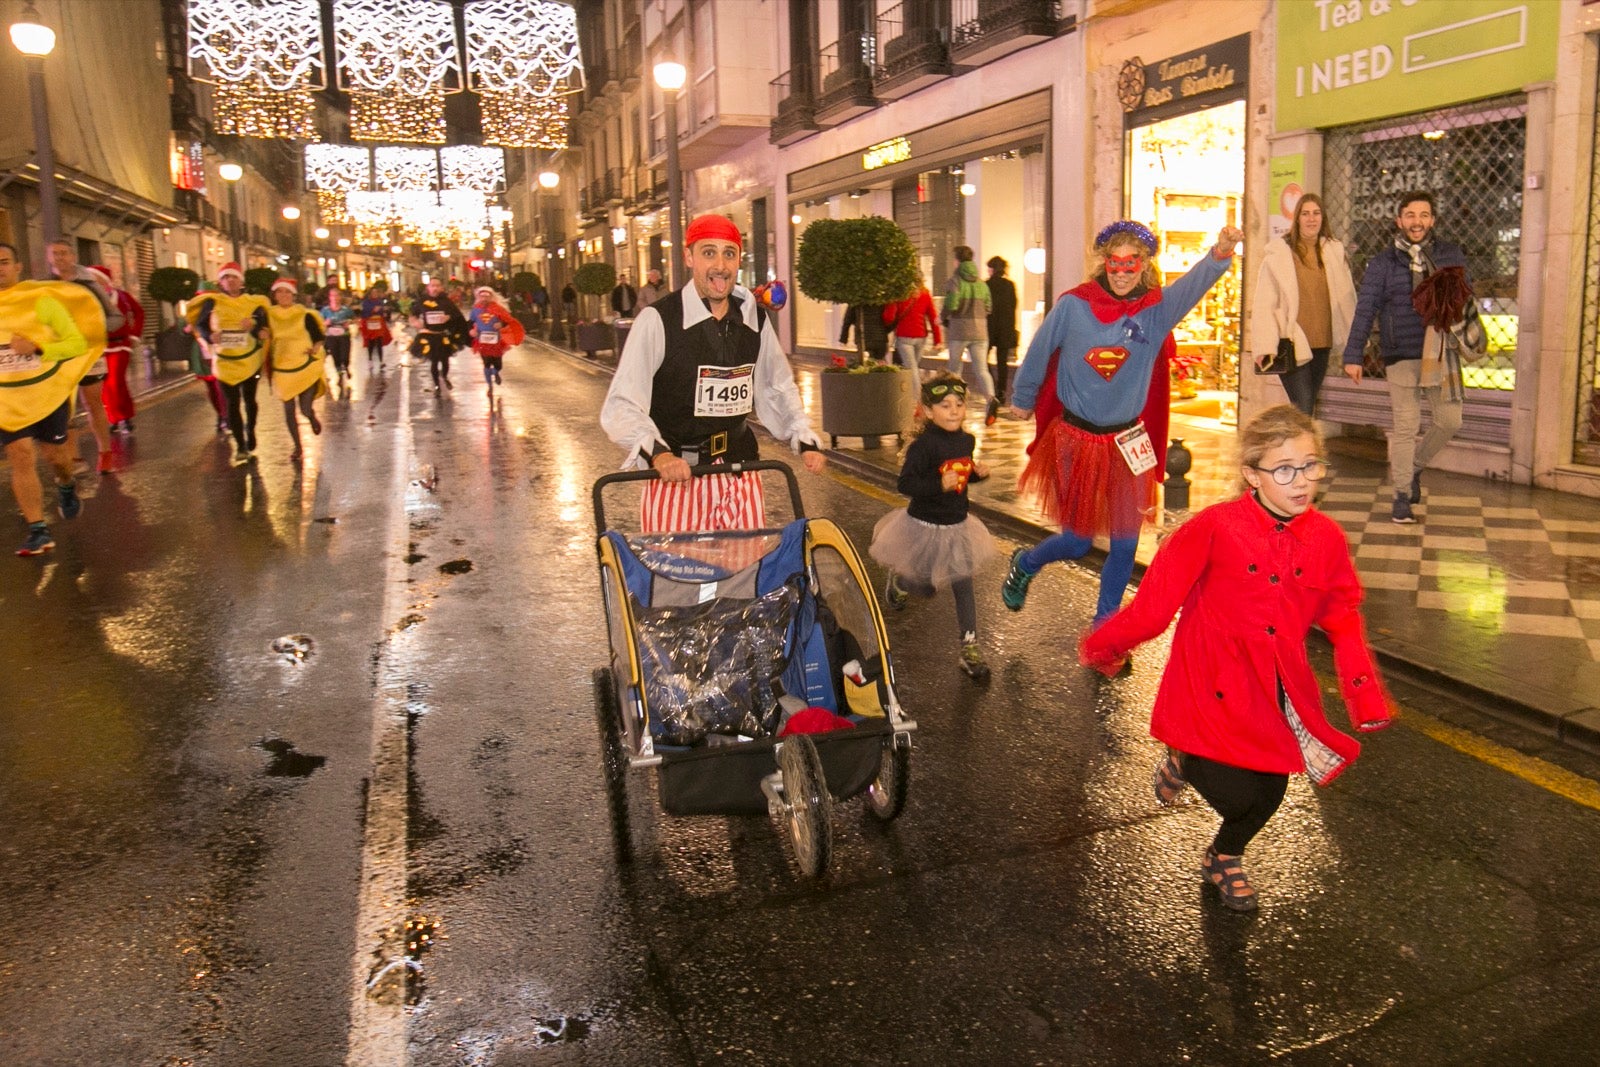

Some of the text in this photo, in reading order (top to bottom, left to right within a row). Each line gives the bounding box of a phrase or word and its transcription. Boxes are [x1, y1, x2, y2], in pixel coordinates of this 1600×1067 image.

[1315, 0, 1363, 31] Tea
[1296, 44, 1394, 97] I NEED
[705, 383, 748, 402] 1496
